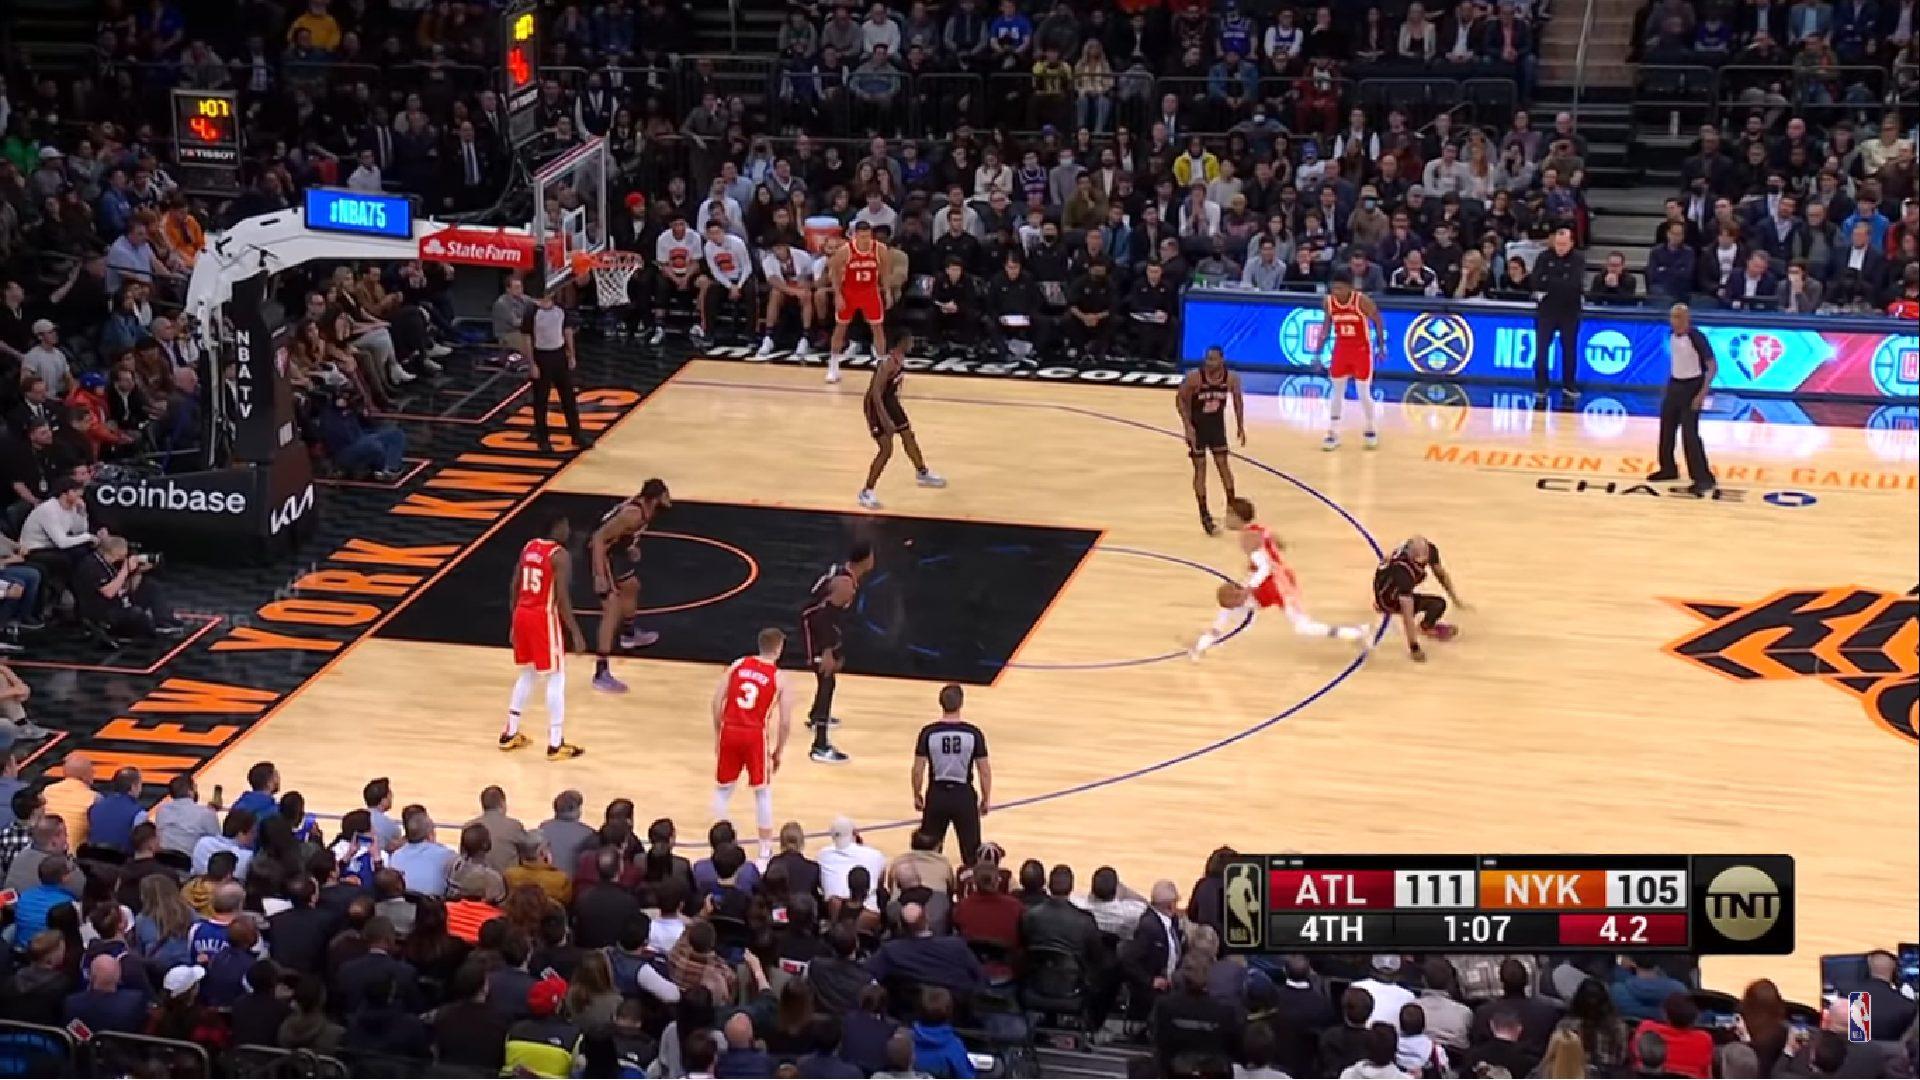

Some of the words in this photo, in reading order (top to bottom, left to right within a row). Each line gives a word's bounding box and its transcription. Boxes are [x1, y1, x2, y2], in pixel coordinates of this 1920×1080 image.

[1424, 444, 1604, 472] MADISON
[96, 479, 246, 514] coinbase
[522, 565, 545, 594] 15
[43, 678, 282, 785] NEW
[207, 538, 462, 651] YORK
[736, 681, 760, 710] 3
